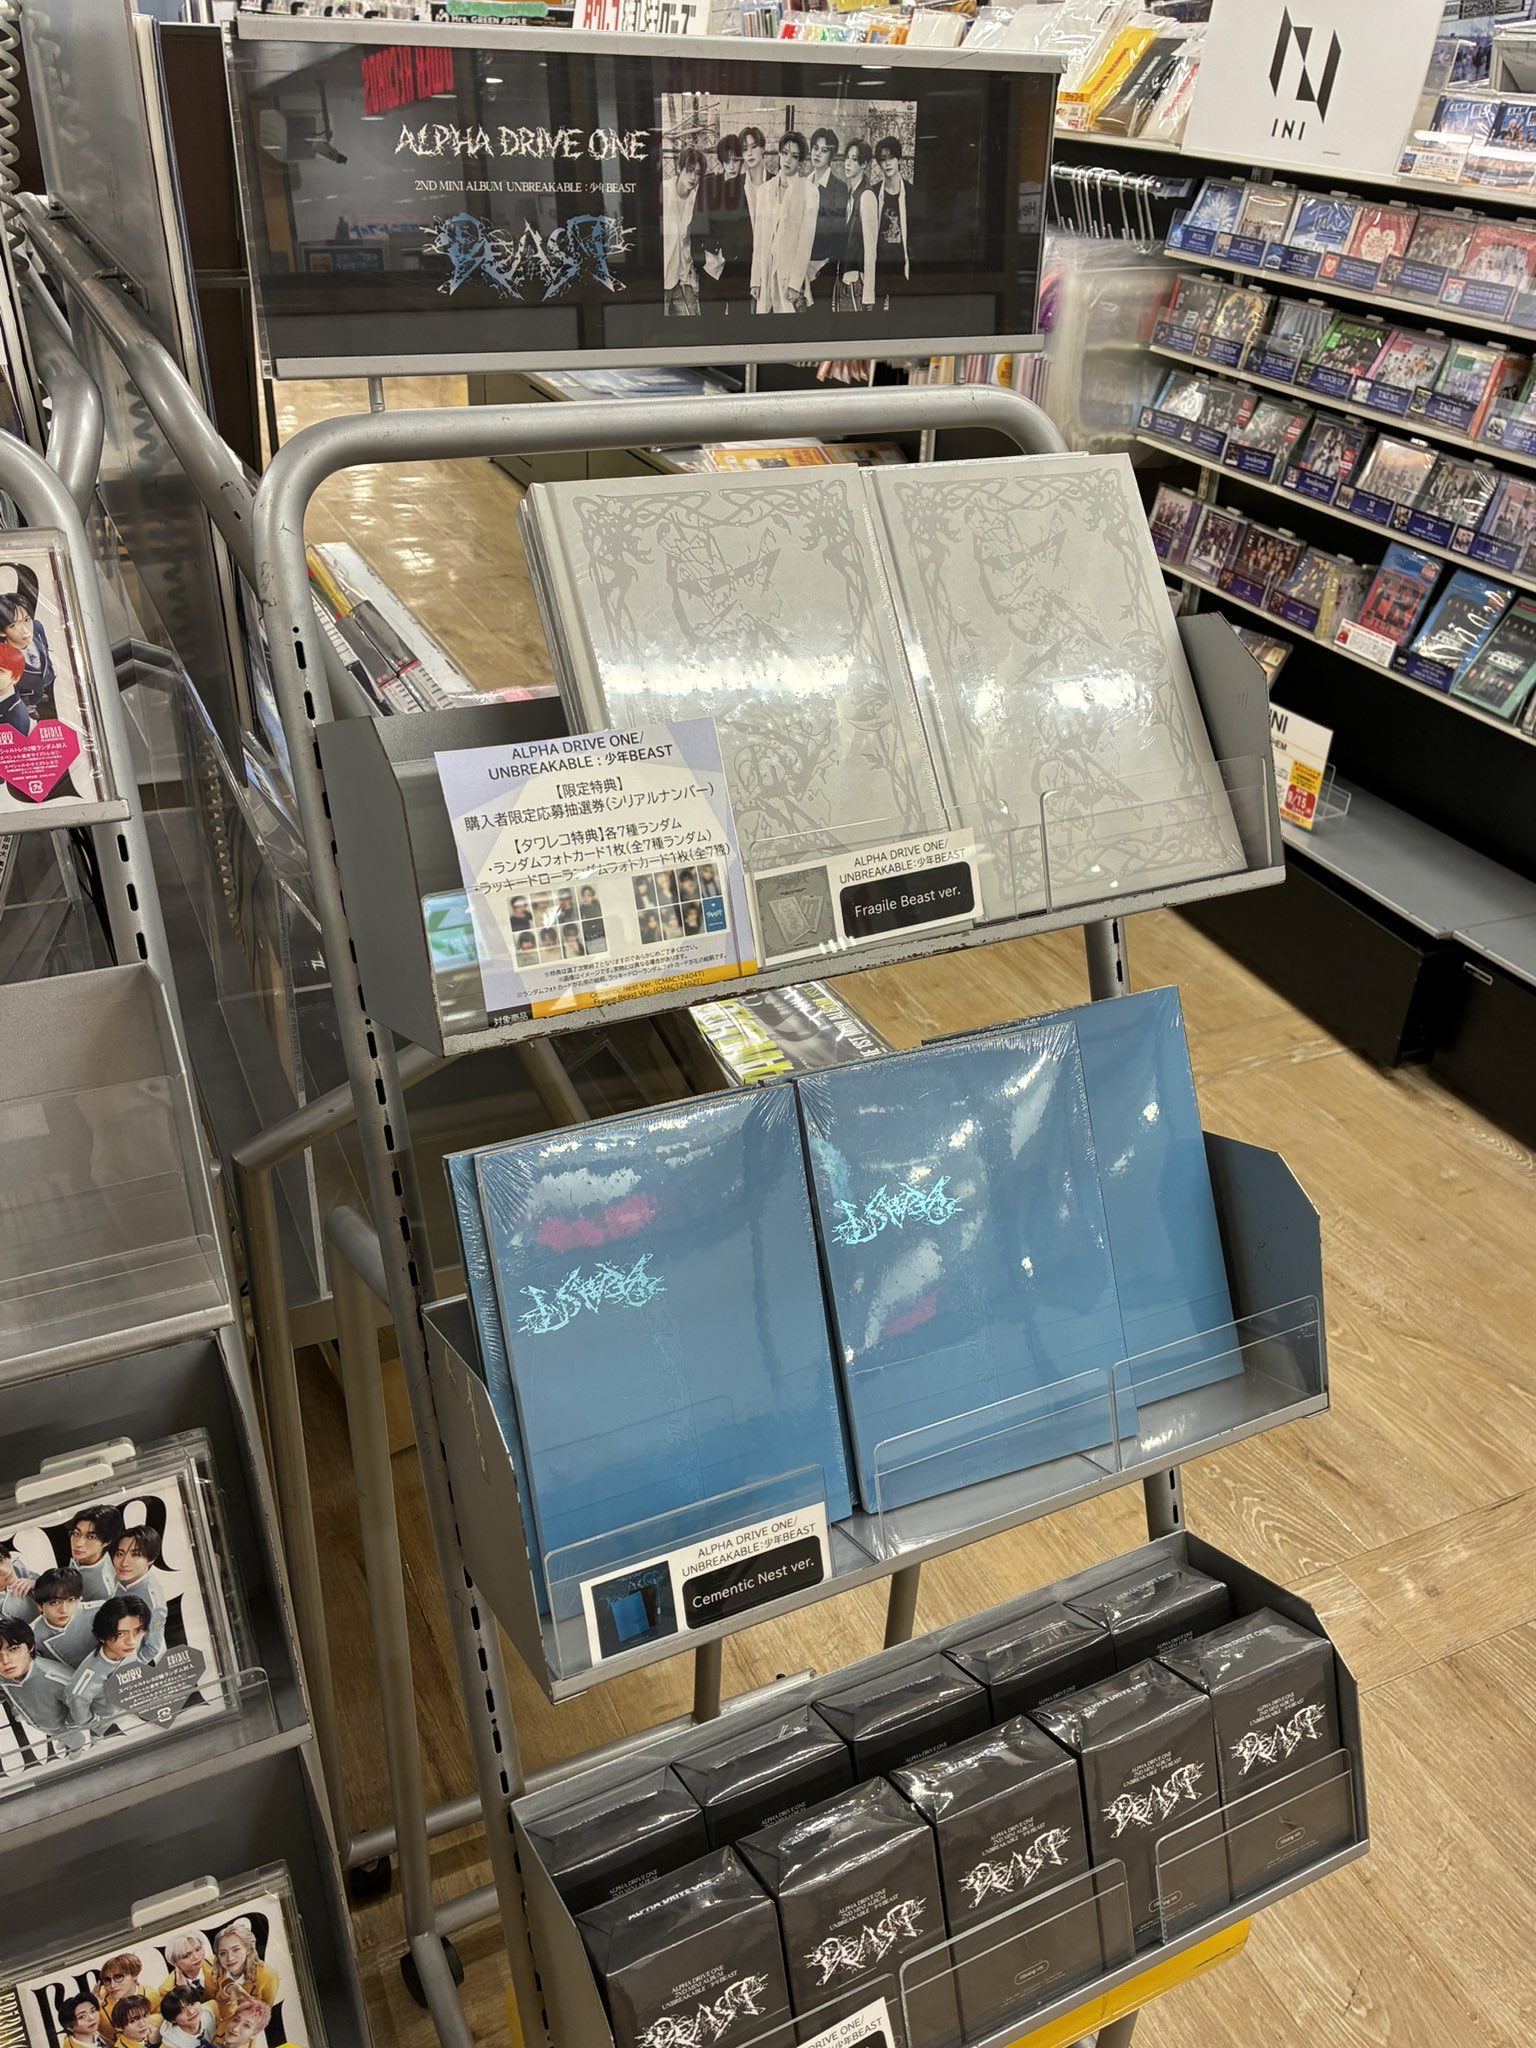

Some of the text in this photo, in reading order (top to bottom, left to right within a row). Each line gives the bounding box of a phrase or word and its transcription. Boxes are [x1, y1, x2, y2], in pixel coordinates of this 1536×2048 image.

[471, 16, 499, 25] GREEN
[500, 16, 528, 26] APPLE
[394, 121, 650, 161] ALPHA DRIVE ONE
[1271, 118, 1306, 141] INI
[414, 181, 437, 191] 2ND
[439, 181, 463, 192] MINI
[466, 181, 503, 192] ALBUM
[506, 181, 582, 193] UNBREAKABLE
[418, 212, 637, 301] BEAST
[1269, 708, 1289, 734] NI
[511, 731, 645, 761] ALPHA DRIVE ONE/
[488, 755, 593, 781] UNBREAKABLE
[604, 744, 673, 767] 少年BEAST
[555, 777, 623, 799] 【限定特典】
[854, 838, 949, 868] ALPHA DRIVE ONE/
[854, 885, 961, 918] Fragile Beast ver.
[697, 1516, 799, 1559] ALPHA DRIVE ONE/
[692, 1558, 815, 1609] Cementic Nest ver.
[838, 1888, 887, 1915] ALPHA DRIVE ONE
[671, 1964, 725, 1994] ALPHA DRIVE ONE
[840, 2014, 865, 2036] ONE/
